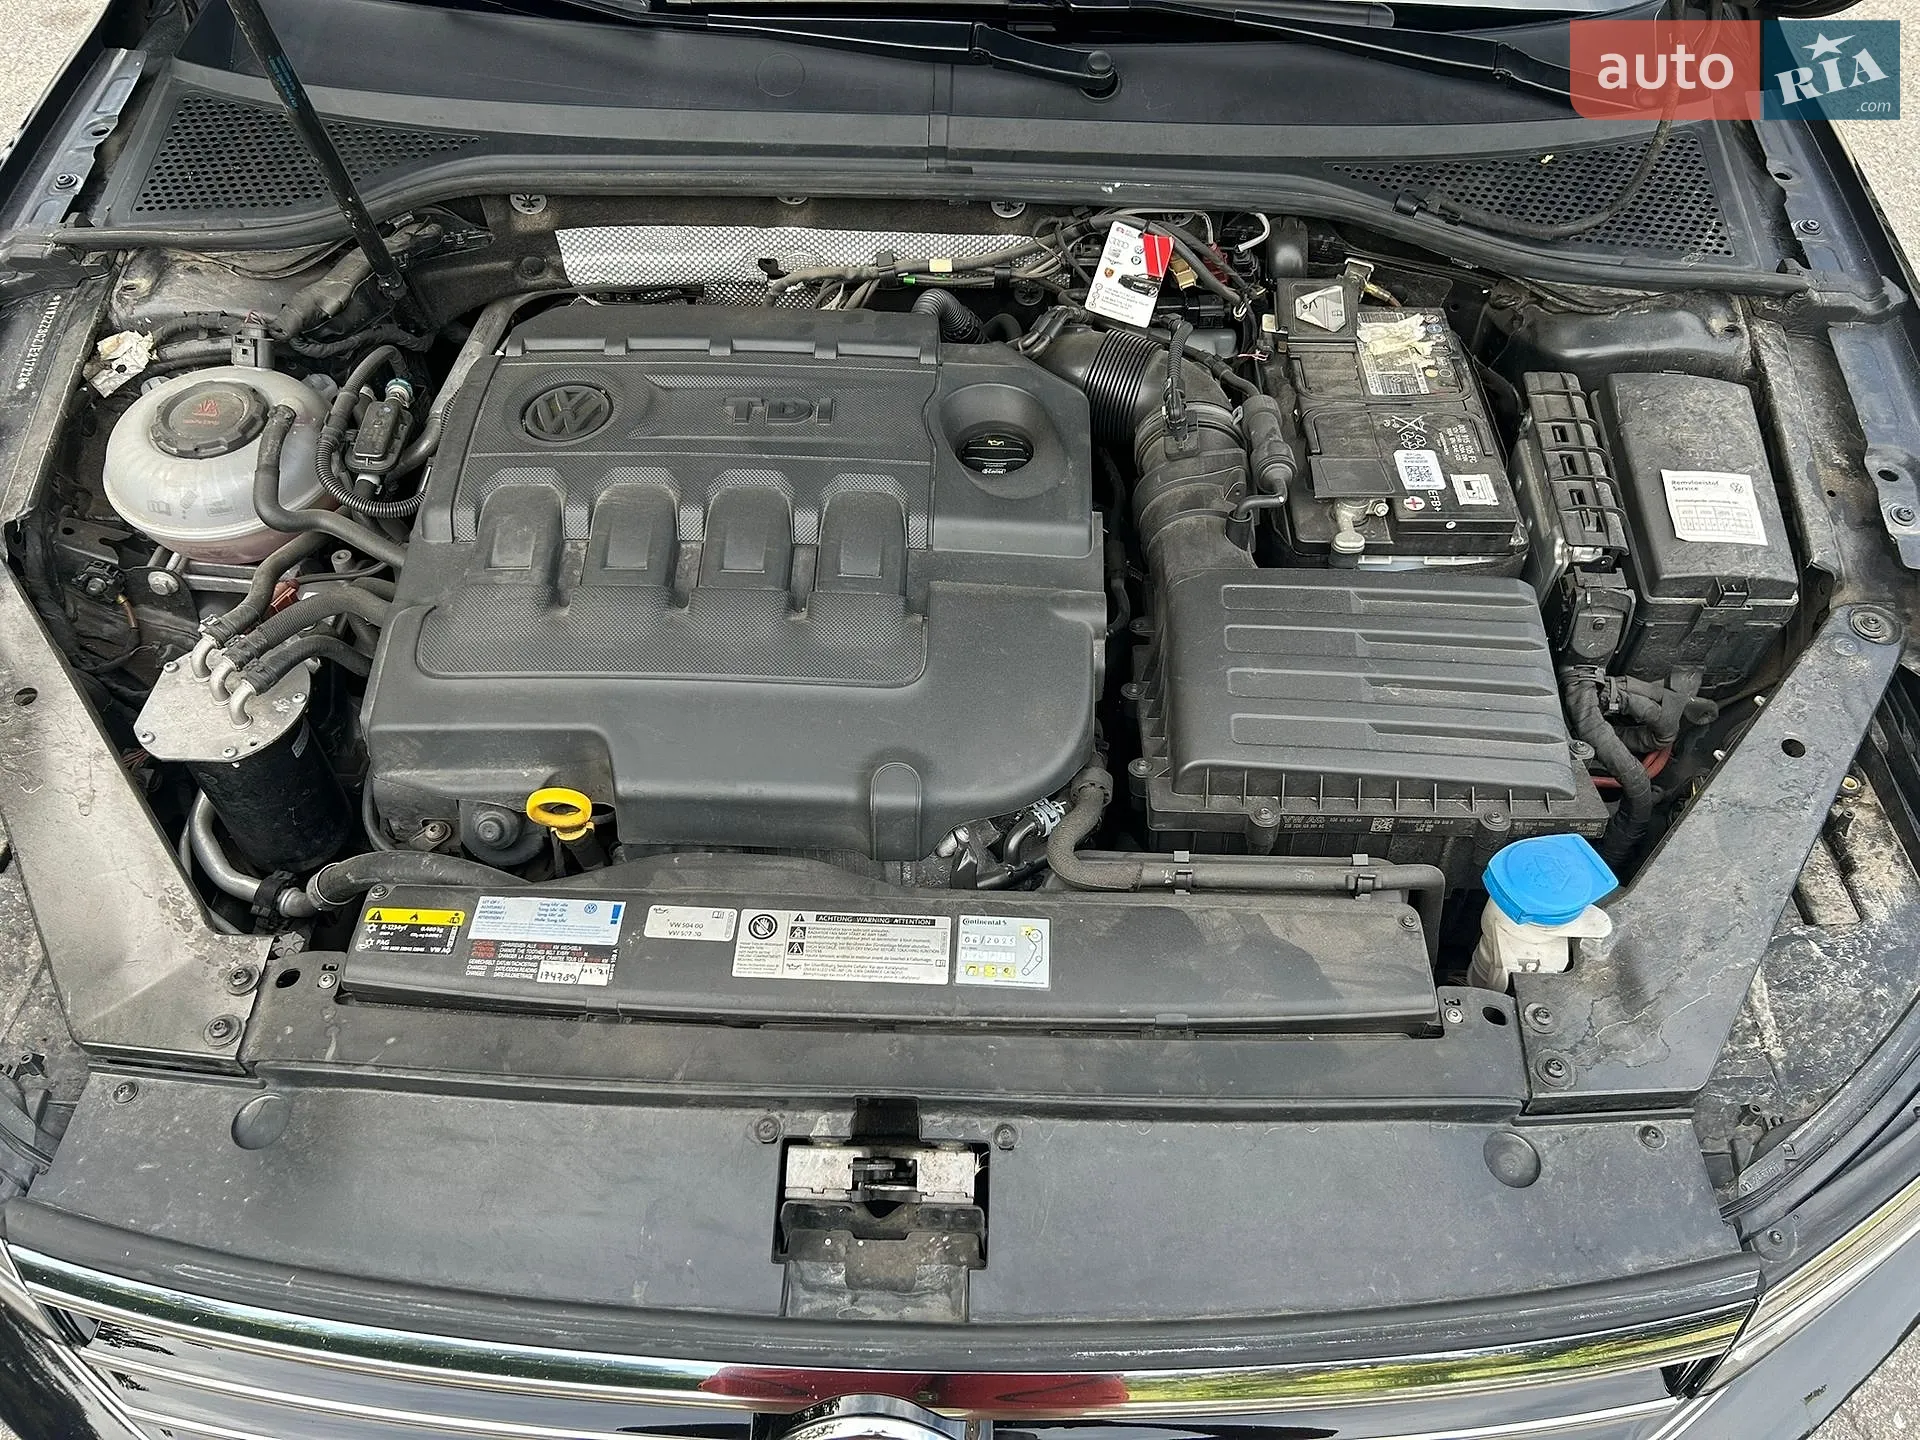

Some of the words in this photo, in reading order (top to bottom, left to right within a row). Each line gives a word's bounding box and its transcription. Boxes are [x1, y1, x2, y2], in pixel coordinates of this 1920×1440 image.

[723, 397, 835, 425] TDI
[818, 915, 853, 923] ACHTUNG
[856, 916, 890, 925] WARNING
[893, 918, 932, 926] ATTENTION
[962, 917, 1002, 926] Continental
